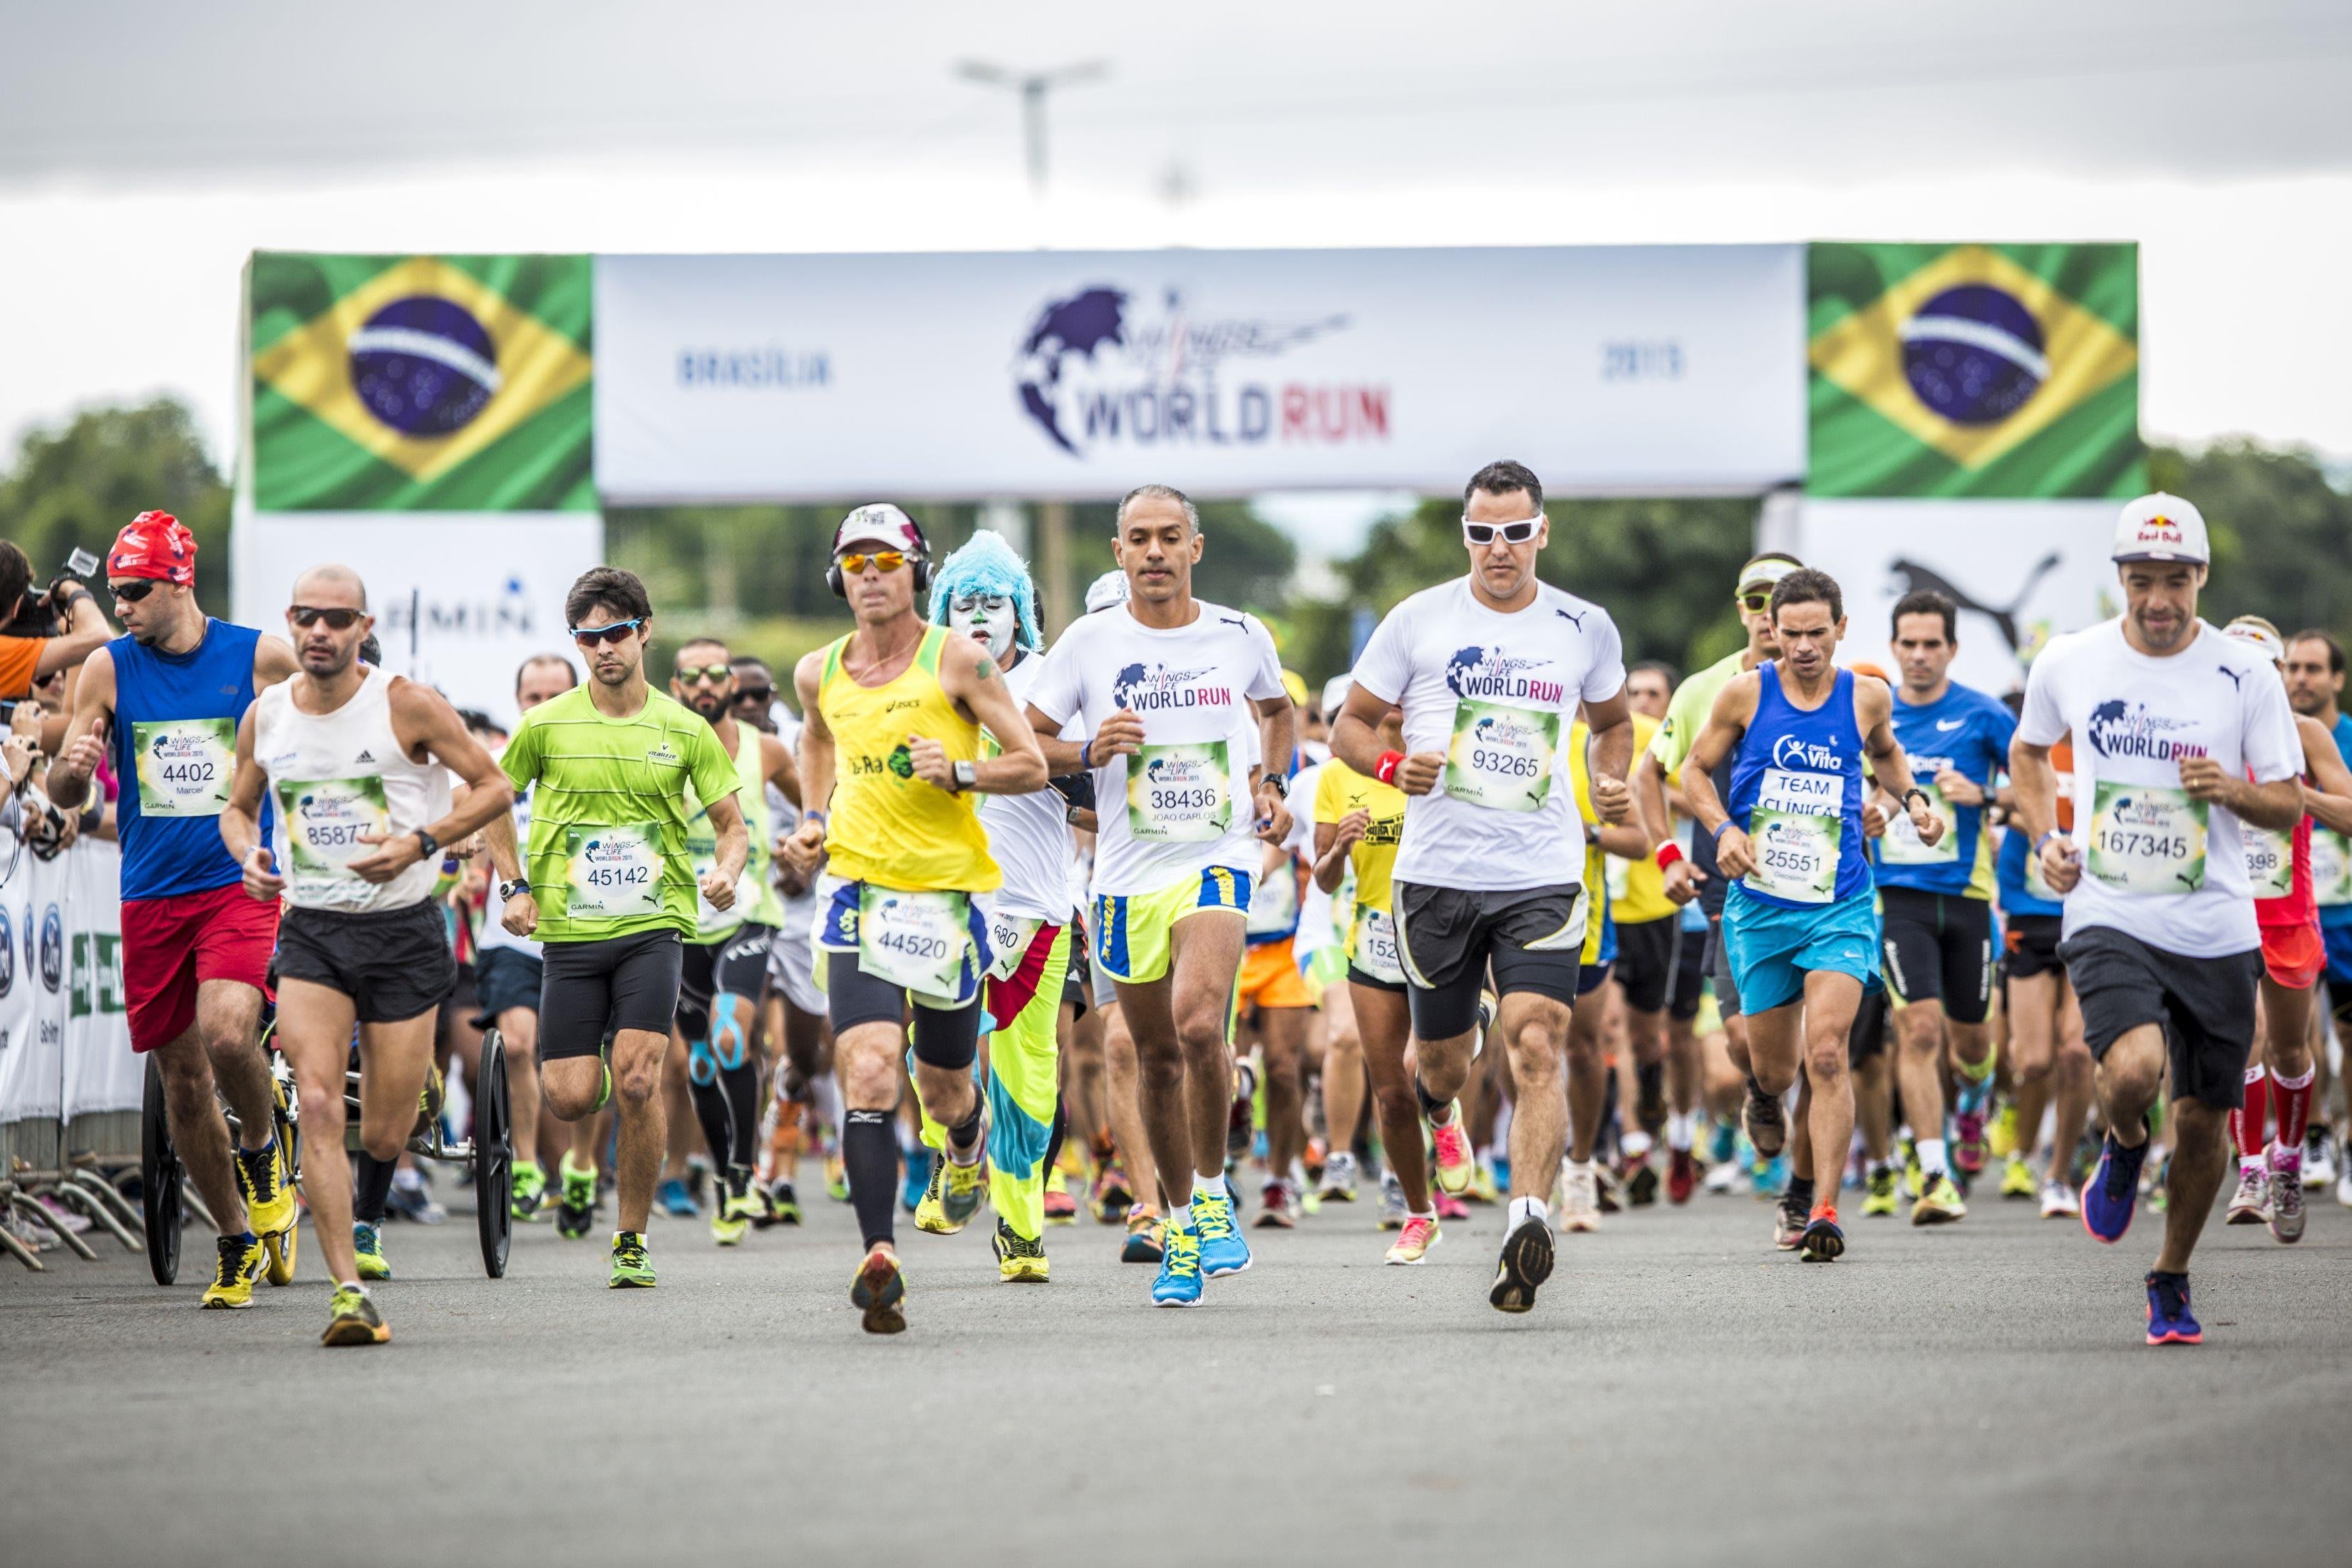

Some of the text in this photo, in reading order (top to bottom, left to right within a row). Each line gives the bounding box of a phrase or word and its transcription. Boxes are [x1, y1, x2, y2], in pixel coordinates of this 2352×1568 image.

[676, 341, 832, 389] BRASÍLIA
[2138, 532, 2182, 544] Red Bull
[1484, 657, 1526, 669] WINGS
[1489, 667, 1512, 677] LIFE
[1145, 671, 1191, 683] WINGS
[1154, 682, 1178, 691] LIFE
[1496, 721, 1529, 734] WINGS
[170, 736, 201, 745] WINGS
[1166, 760, 1197, 769] WINGS
[1472, 749, 1538, 778] 93265
[1807, 751, 1842, 770] Vita
[163, 763, 215, 782] 4402
[1447, 784, 1483, 798] GARMIN
[1779, 776, 1830, 795] TEAM
[1151, 788, 1216, 809] 38436
[1179, 812, 1217, 821] CARLOS
[307, 822, 371, 846] 85877
[2098, 830, 2187, 859] 167345
[1765, 849, 1820, 872] 25551
[588, 866, 648, 886] 45142
[879, 930, 947, 959] 44520
[994, 924, 1018, 949] 680
[1368, 938, 1397, 959] 152
